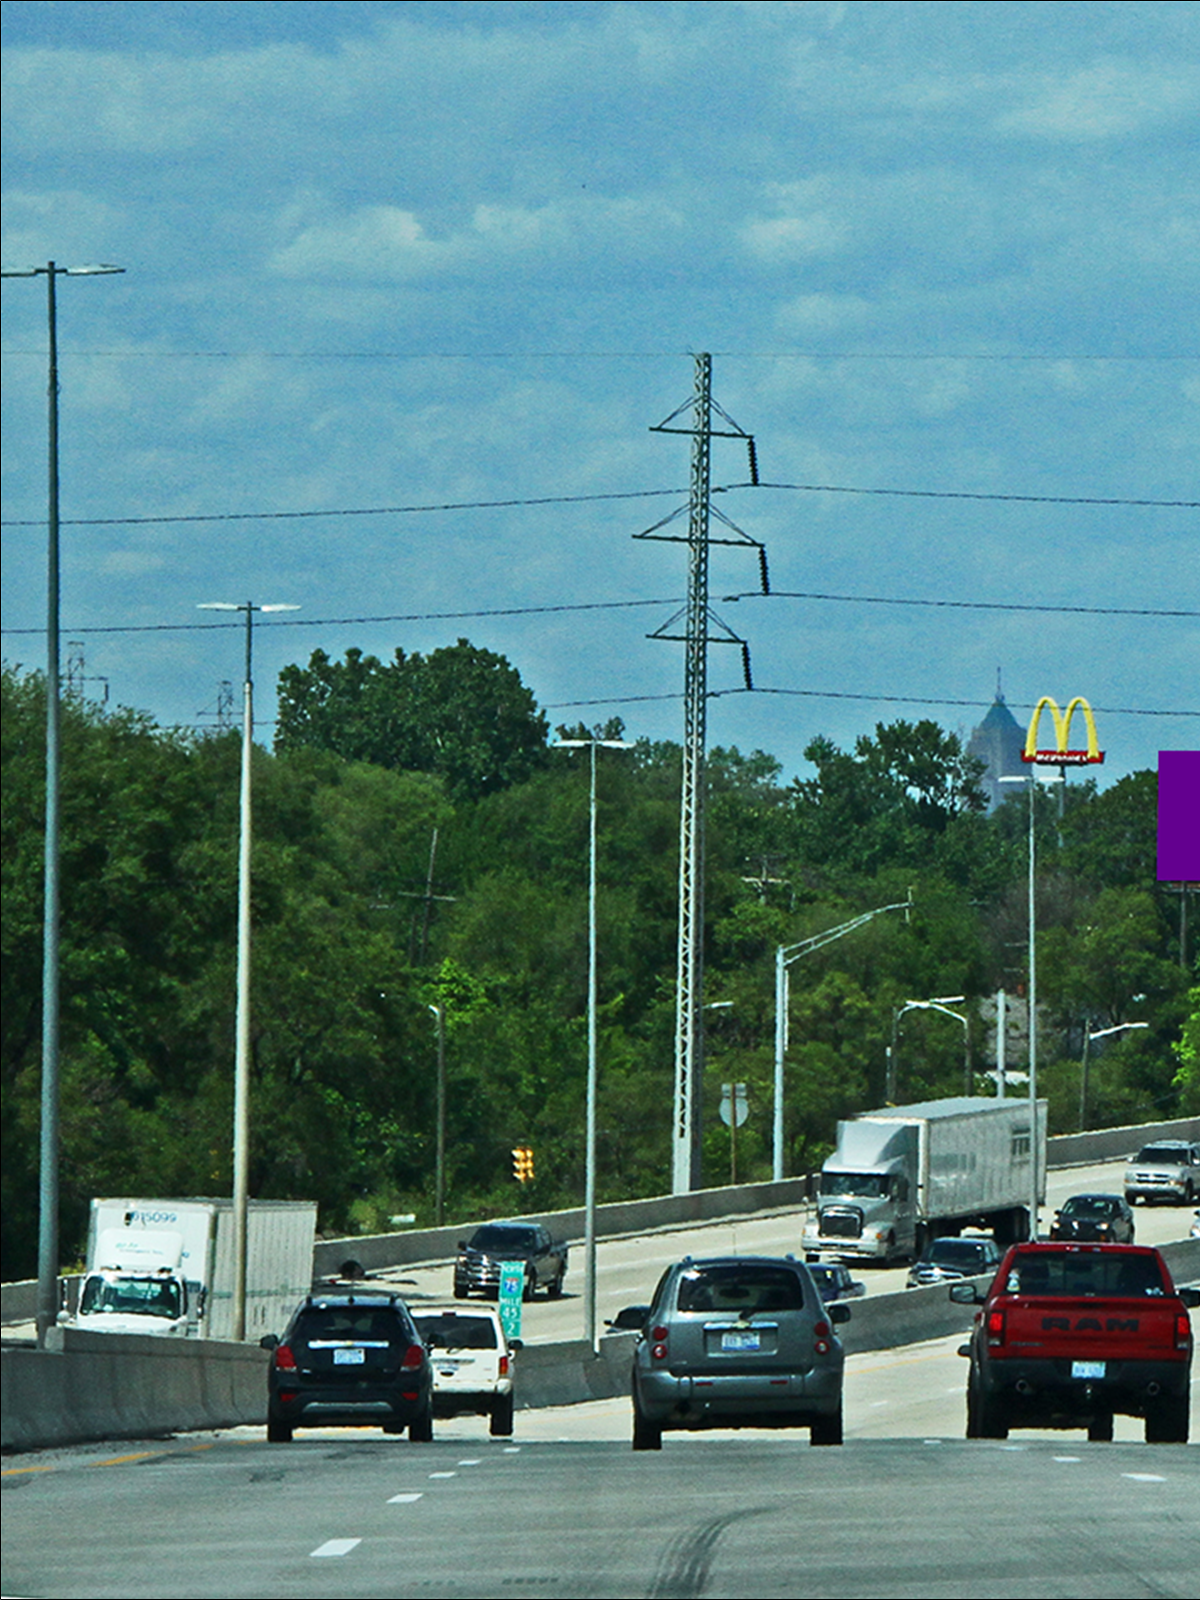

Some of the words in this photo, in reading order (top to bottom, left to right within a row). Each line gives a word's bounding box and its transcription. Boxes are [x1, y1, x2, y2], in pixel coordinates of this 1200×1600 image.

[506, 1281, 518, 1291] 75
[501, 1296, 521, 1306] MILE
[503, 1307, 517, 1319] 45
[508, 1322, 515, 1335] 2
[1042, 1317, 1140, 1332] RAM
